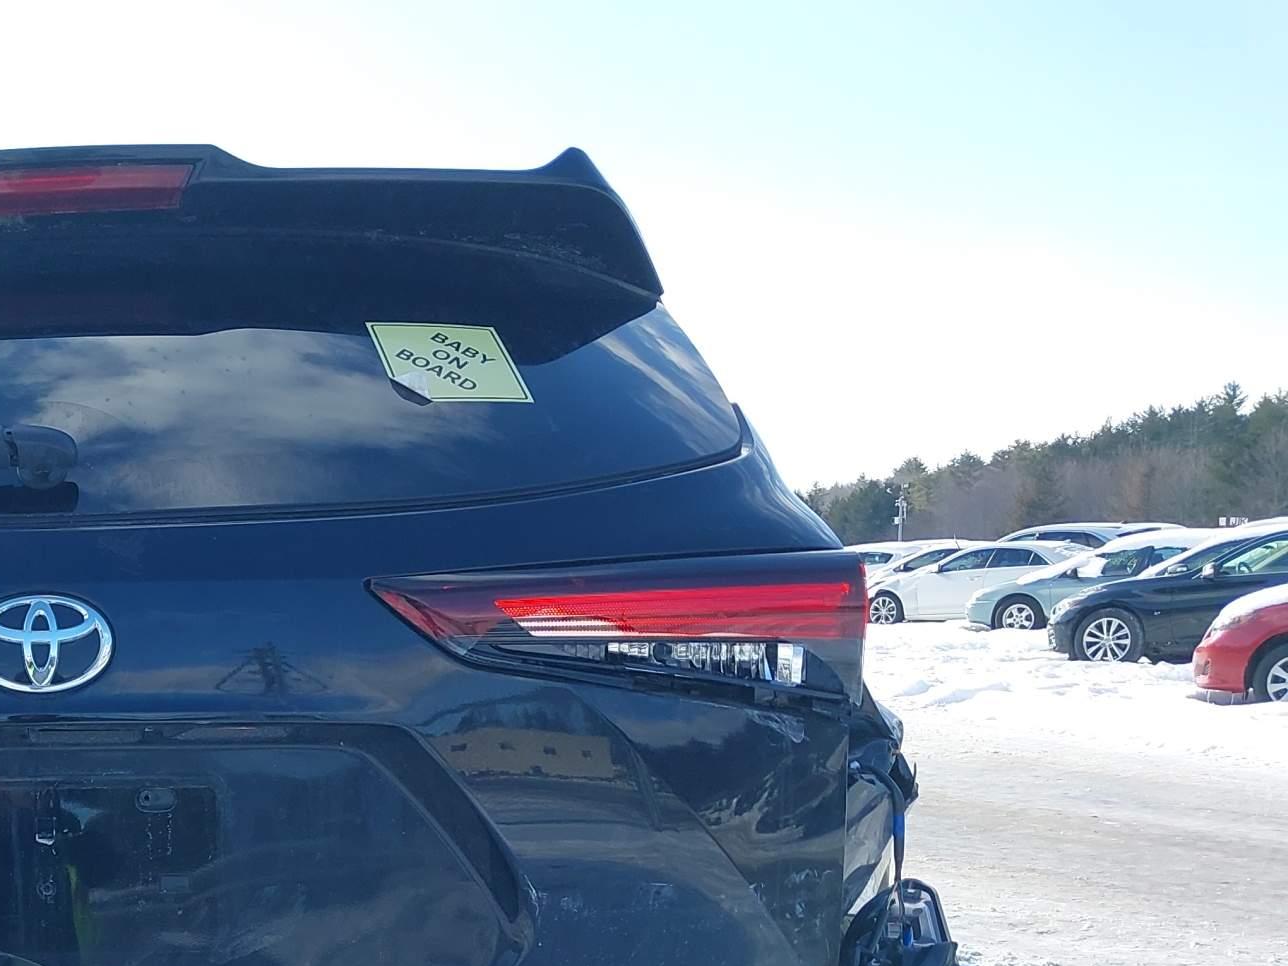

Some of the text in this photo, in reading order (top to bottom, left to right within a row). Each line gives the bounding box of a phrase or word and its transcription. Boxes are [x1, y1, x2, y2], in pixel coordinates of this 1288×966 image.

[430, 332, 496, 364] BABY
[432, 349, 469, 370] ON
[395, 348, 478, 391] BOARD
